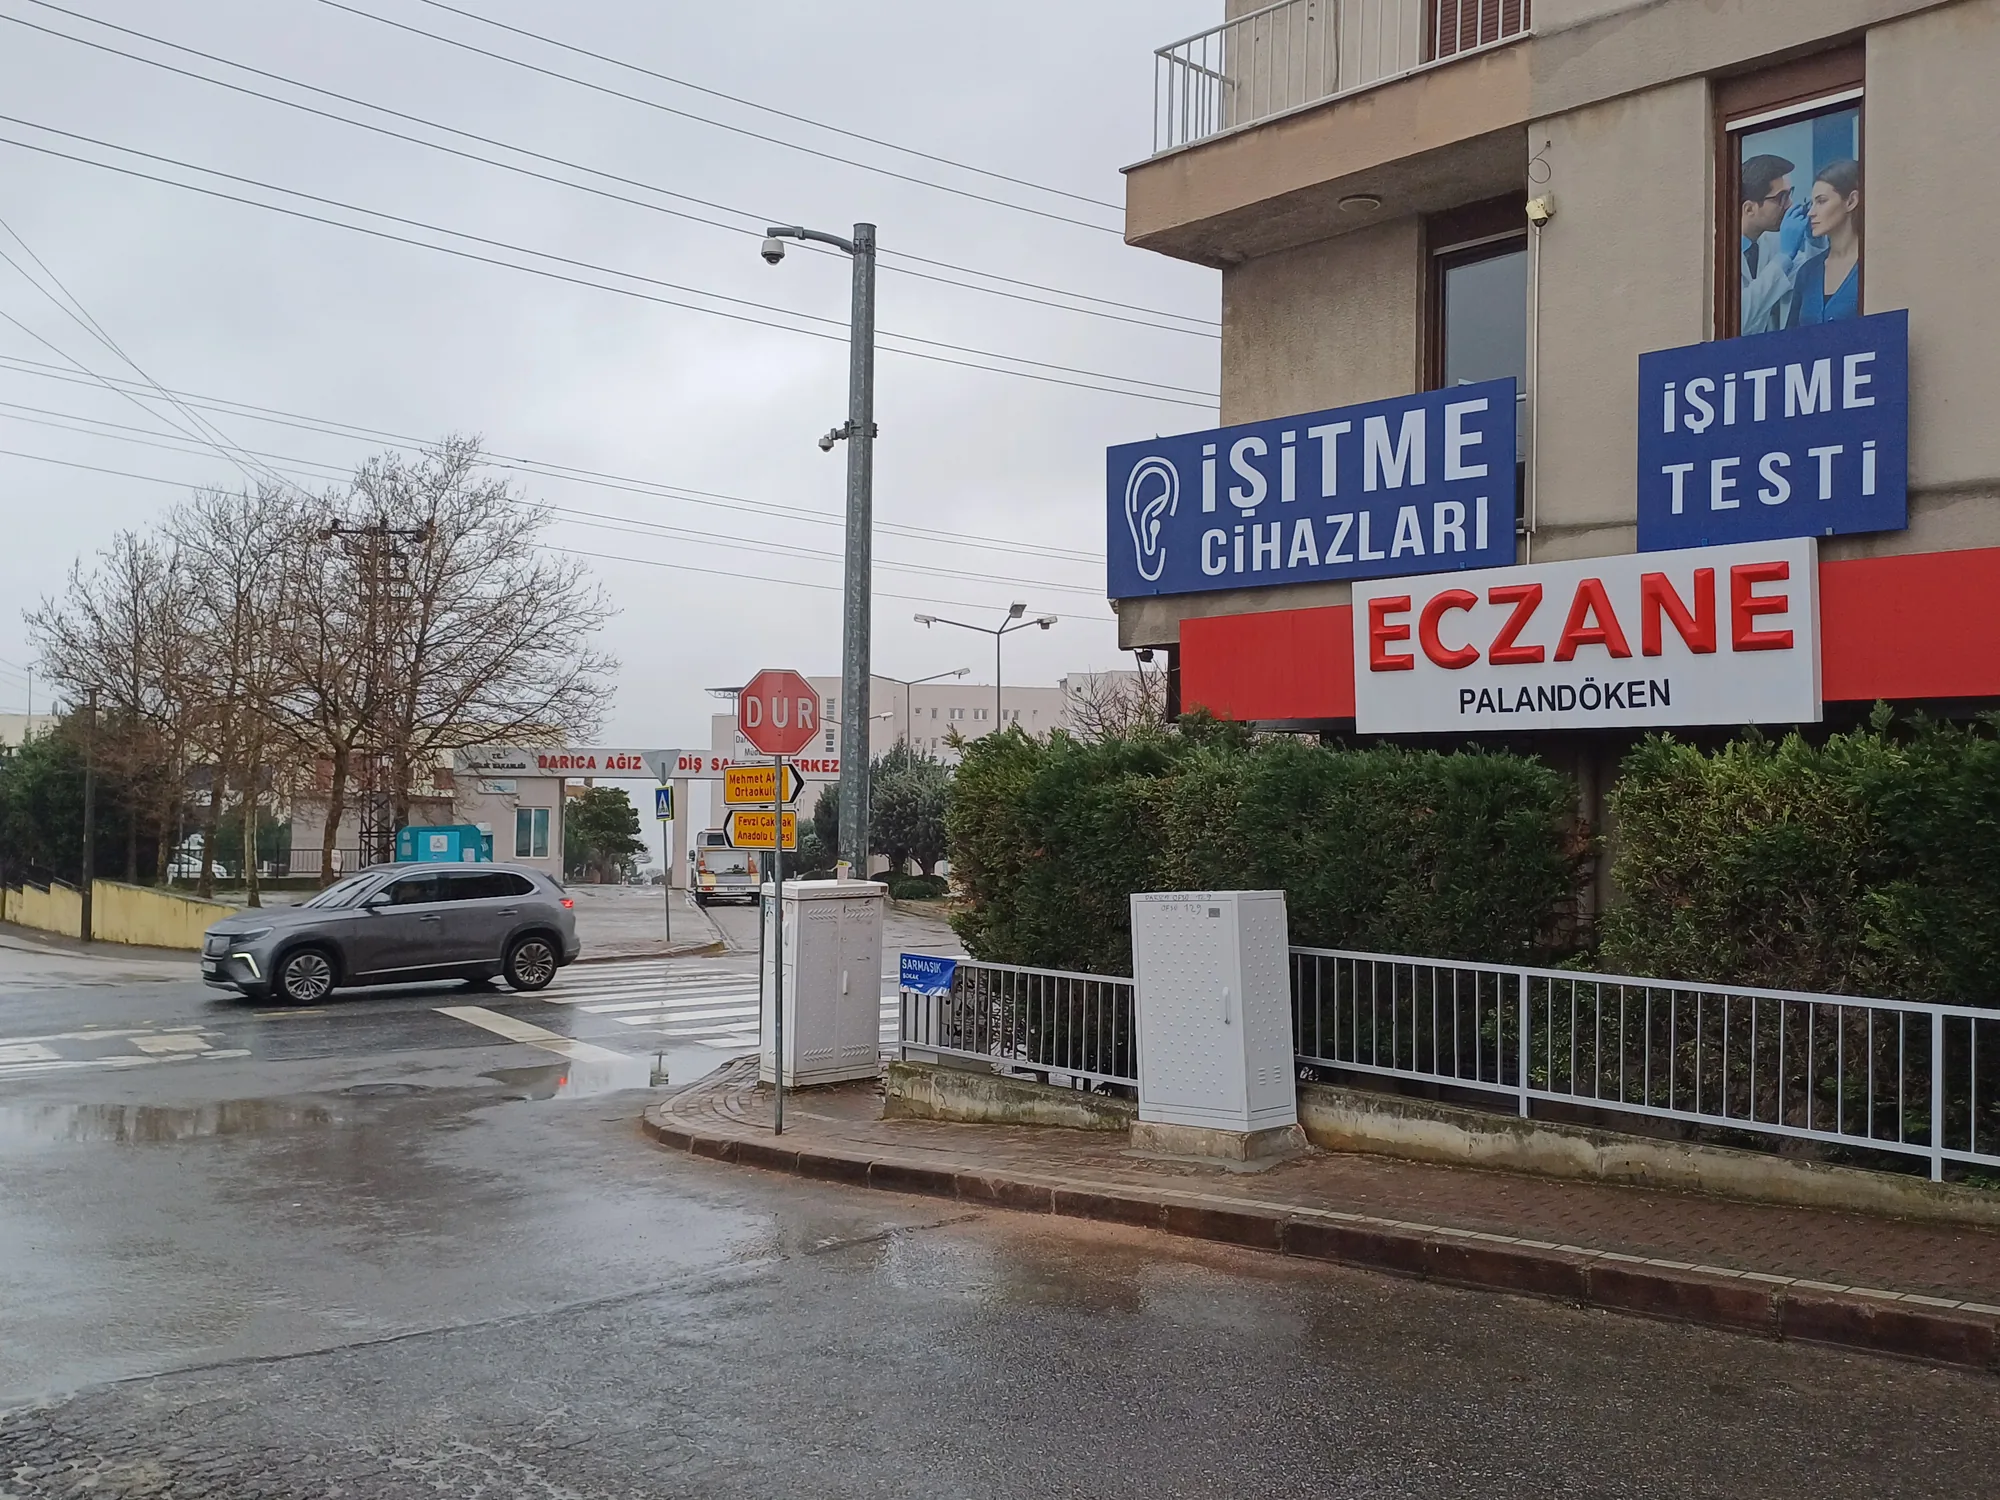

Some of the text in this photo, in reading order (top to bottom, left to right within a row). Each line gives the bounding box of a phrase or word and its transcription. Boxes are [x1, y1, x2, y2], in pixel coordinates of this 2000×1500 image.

[1663, 351, 1876, 434] İŞİTME
[1202, 398, 1488, 517] İŞİTME
[1661, 440, 1876, 515] TESTİ
[1201, 496, 1488, 576] CİHAZLARI
[1368, 561, 1794, 672] ECZANE
[746, 696, 813, 729] DUR
[1460, 677, 1671, 714] PALANDÖKEN
[538, 755, 597, 769] DARICA
[605, 753, 642, 770] AĞIZ
[678, 754, 703, 773] DİŞ
[792, 759, 839, 773] ERKEZ
[729, 774, 763, 784] Mehmet
[738, 816, 791, 828] Fevzi Çakak
[738, 831, 793, 842] Anadolu Lesi
